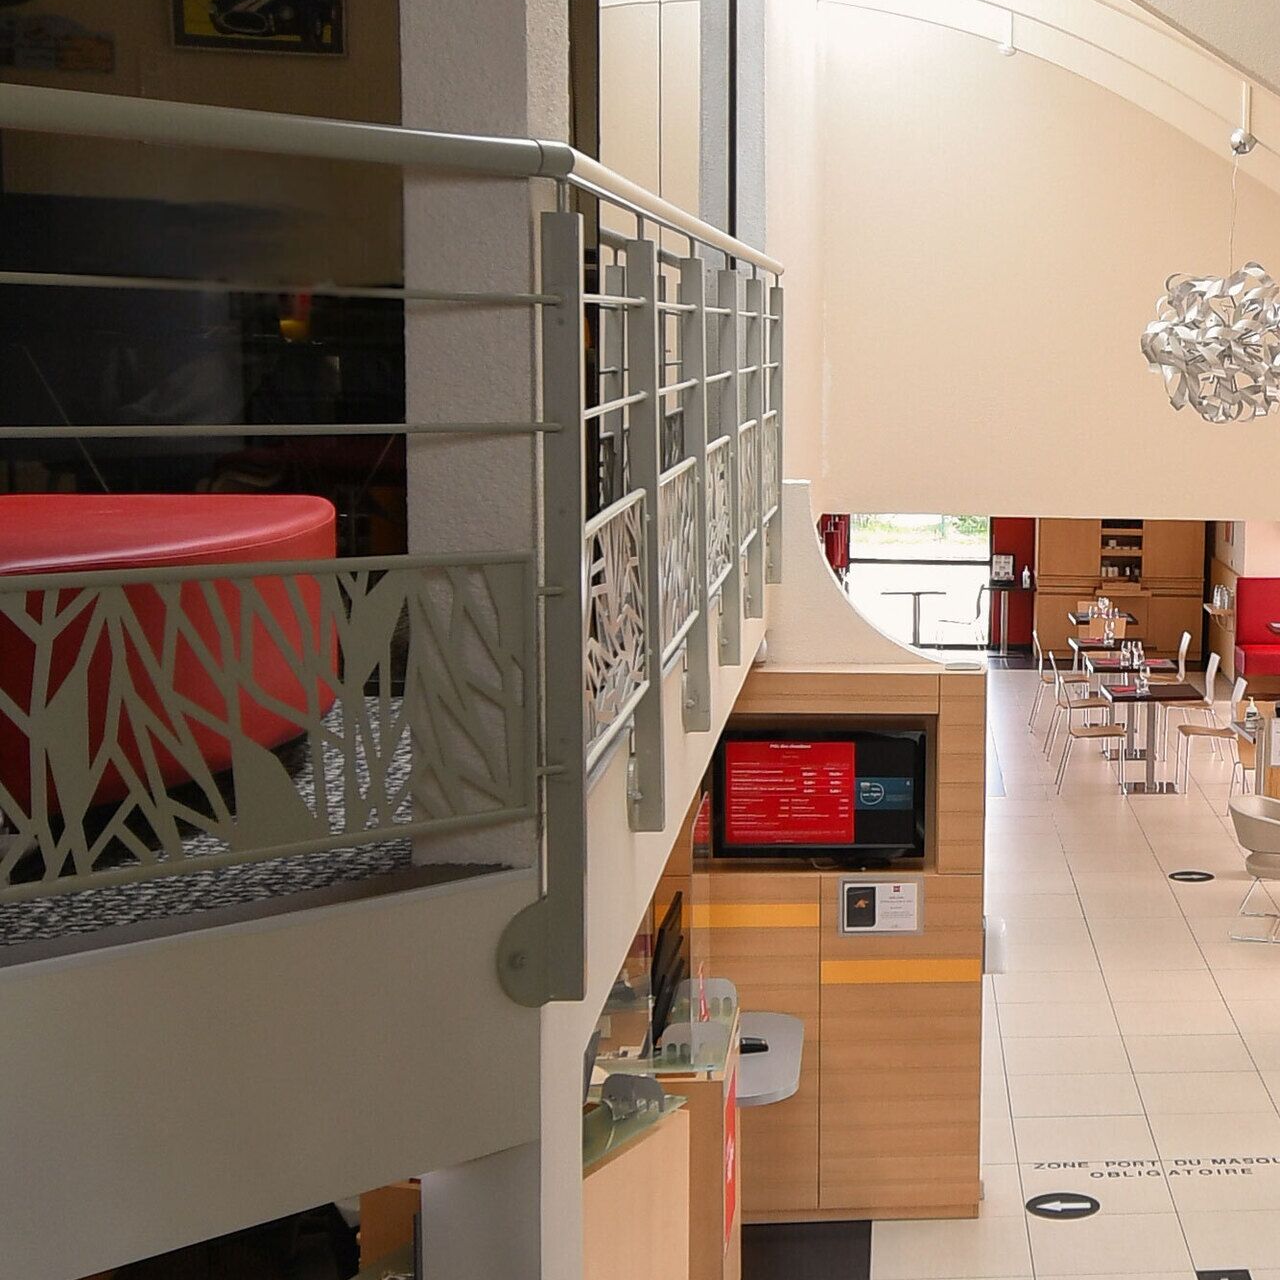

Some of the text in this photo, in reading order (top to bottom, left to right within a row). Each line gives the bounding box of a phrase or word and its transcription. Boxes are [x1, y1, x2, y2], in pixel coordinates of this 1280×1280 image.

[1033, 1161, 1089, 1170] ZONE
[1105, 1160, 1159, 1168] PORT
[1090, 1168, 1254, 1178] OBLIGATOIRE
